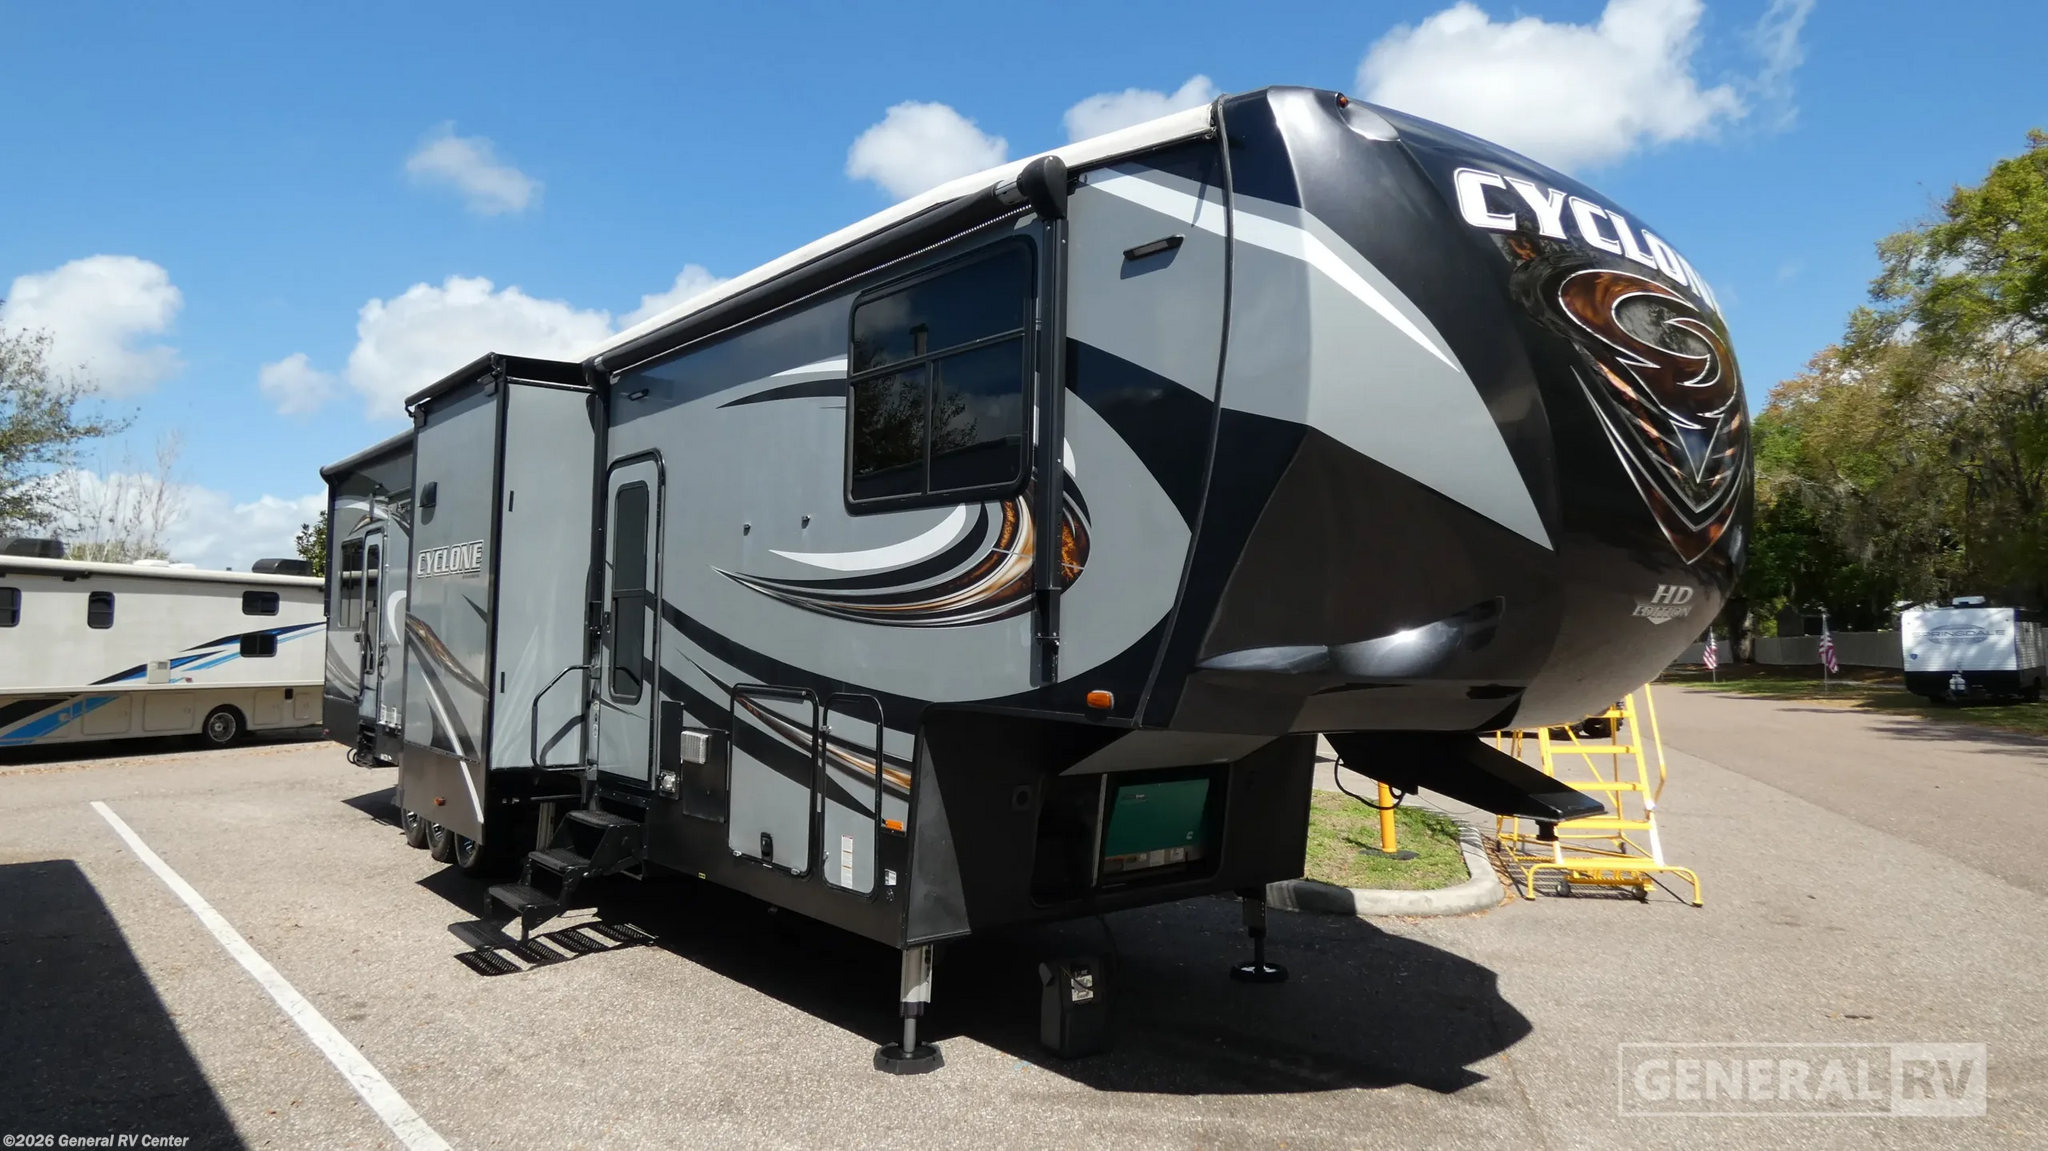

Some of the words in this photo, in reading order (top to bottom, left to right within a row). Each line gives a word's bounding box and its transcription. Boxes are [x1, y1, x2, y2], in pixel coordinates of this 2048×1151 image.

[1453, 167, 1722, 320] CYCLON
[417, 540, 483, 579] CYCLONE
[1650, 584, 1693, 604] HD
[1631, 604, 1693, 618] EDITION
[1912, 629, 2005, 638] SPRINGDALE
